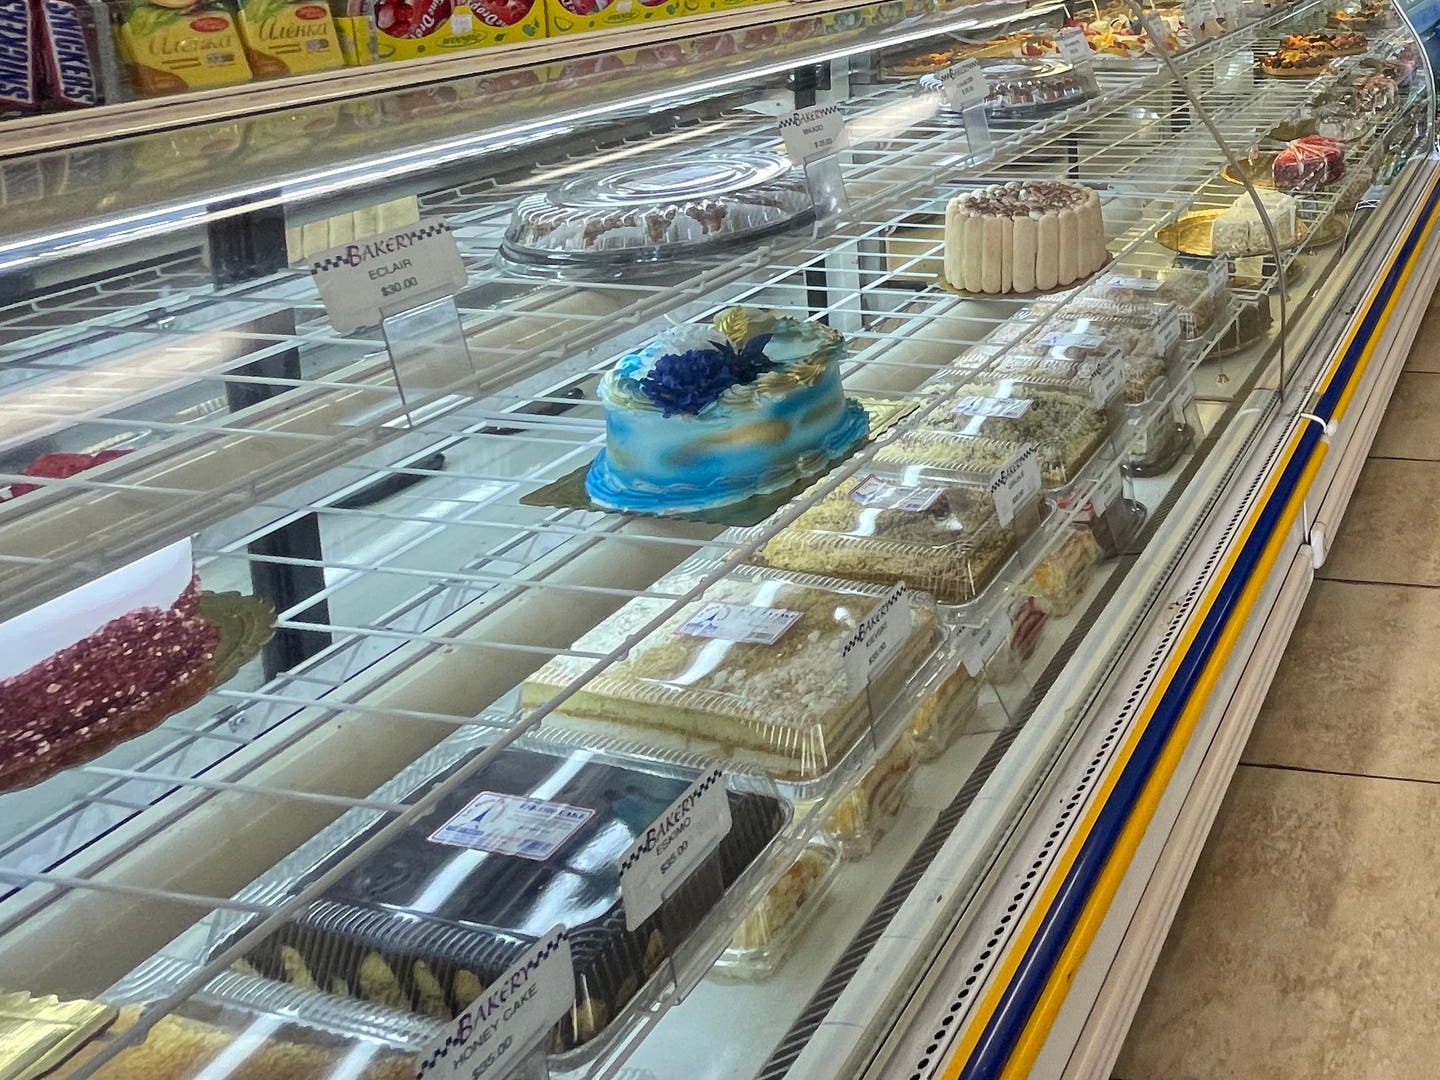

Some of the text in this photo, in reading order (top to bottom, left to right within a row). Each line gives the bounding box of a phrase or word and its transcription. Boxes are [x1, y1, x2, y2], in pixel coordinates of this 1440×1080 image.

[792, 109, 824, 127] BAKERY
[346, 232, 415, 267] BAKERY
[368, 258, 413, 281] ECLAIR
[381, 276, 418, 297] $30.00
[858, 602, 889, 642] BAKERY
[645, 795, 696, 852] BAKERY
[656, 816, 691, 856] ESKIMO
[453, 982, 538, 1070] HONEY CAKE
[456, 966, 529, 1046] BAKERY
[471, 1034, 513, 1080] $35.00
